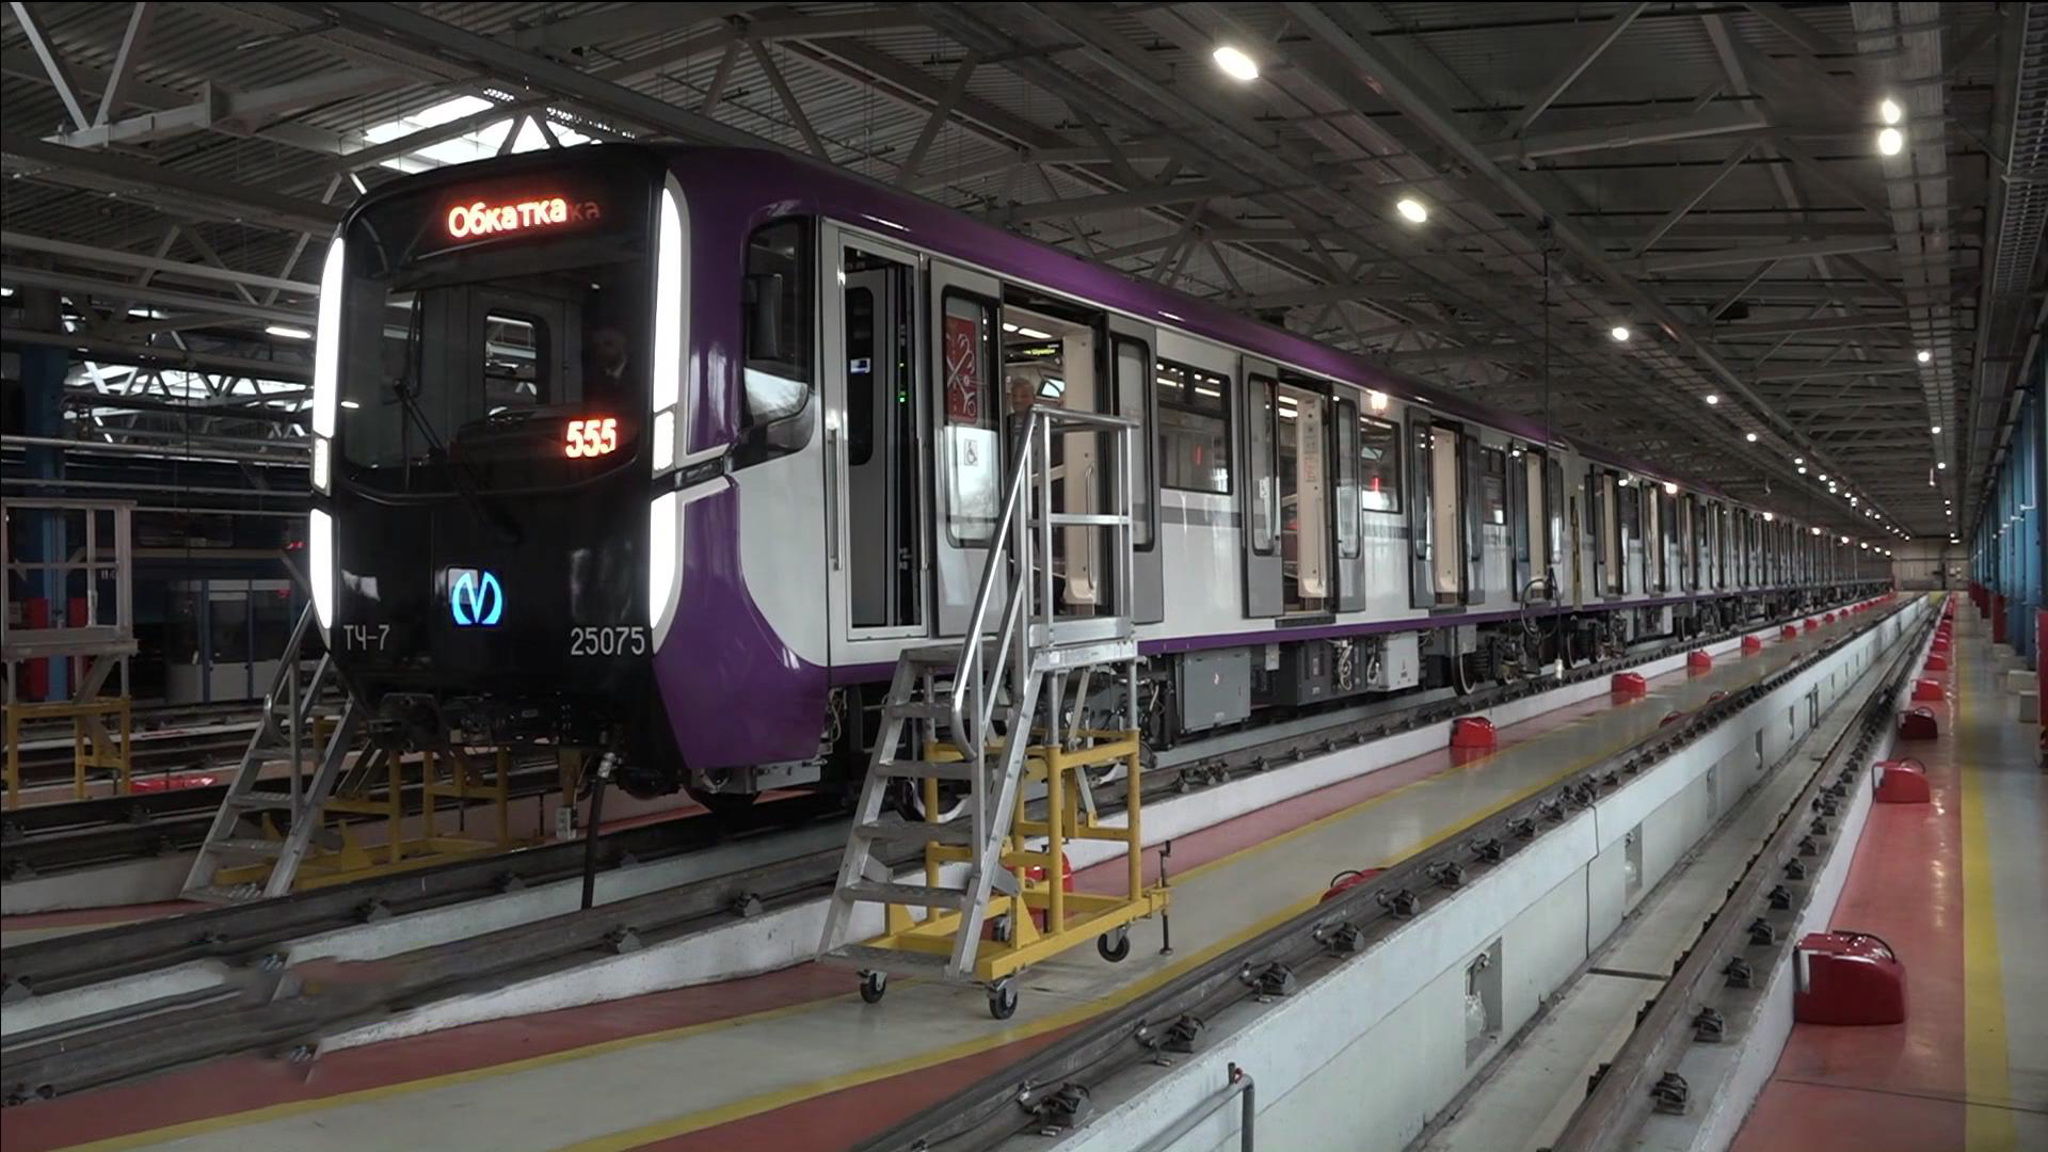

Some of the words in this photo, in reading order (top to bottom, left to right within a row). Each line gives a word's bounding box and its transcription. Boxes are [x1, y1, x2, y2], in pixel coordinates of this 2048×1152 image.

[448, 198, 567, 238] Обкатка
[565, 418, 617, 458] 555
[343, 625, 390, 650] ТЧ-7
[571, 627, 645, 655] 25075
